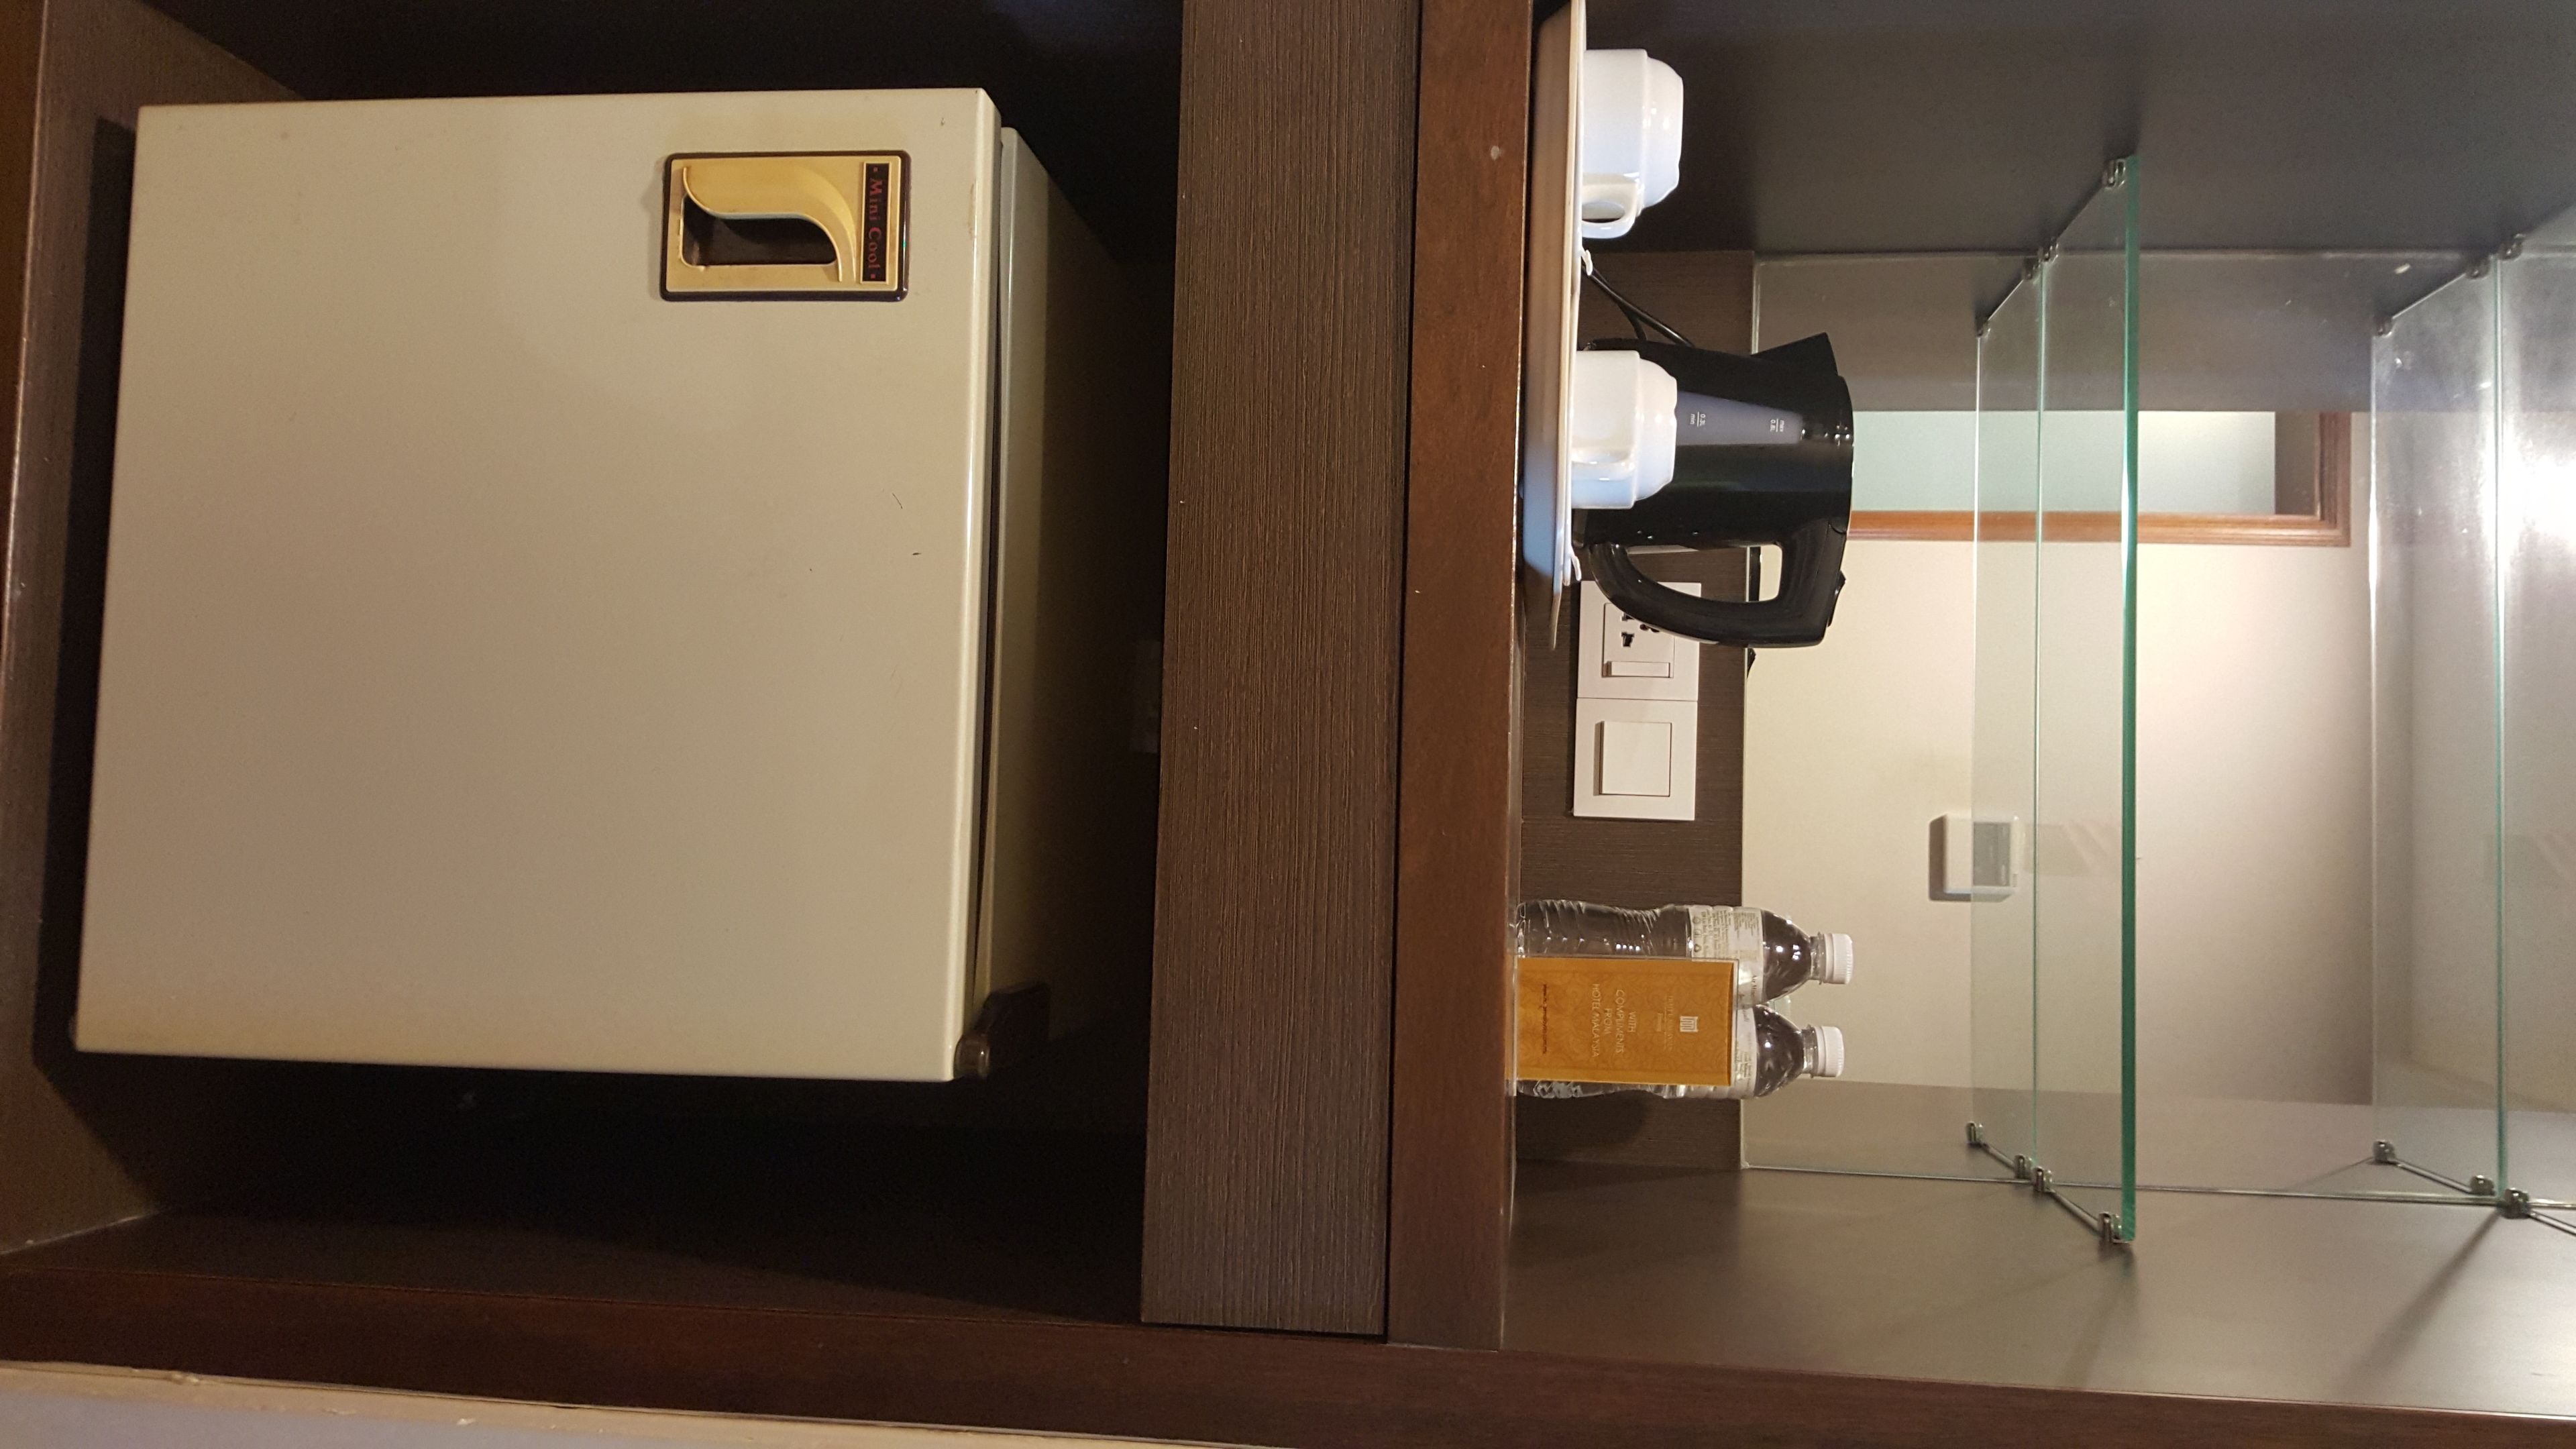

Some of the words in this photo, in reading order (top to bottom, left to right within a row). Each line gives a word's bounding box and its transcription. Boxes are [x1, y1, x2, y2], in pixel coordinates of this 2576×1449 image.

[869, 178, 883, 221] Mini
[868, 226, 882, 270] Cool
[1592, 983, 1601, 1010] HOTEL
[1591, 1012, 1601, 1058] MALAYSIA
[1604, 1008, 1613, 1034] FROM
[1615, 989, 1625, 1053] COMPLIMENTS
[1627, 1011, 1637, 1032] WITH
